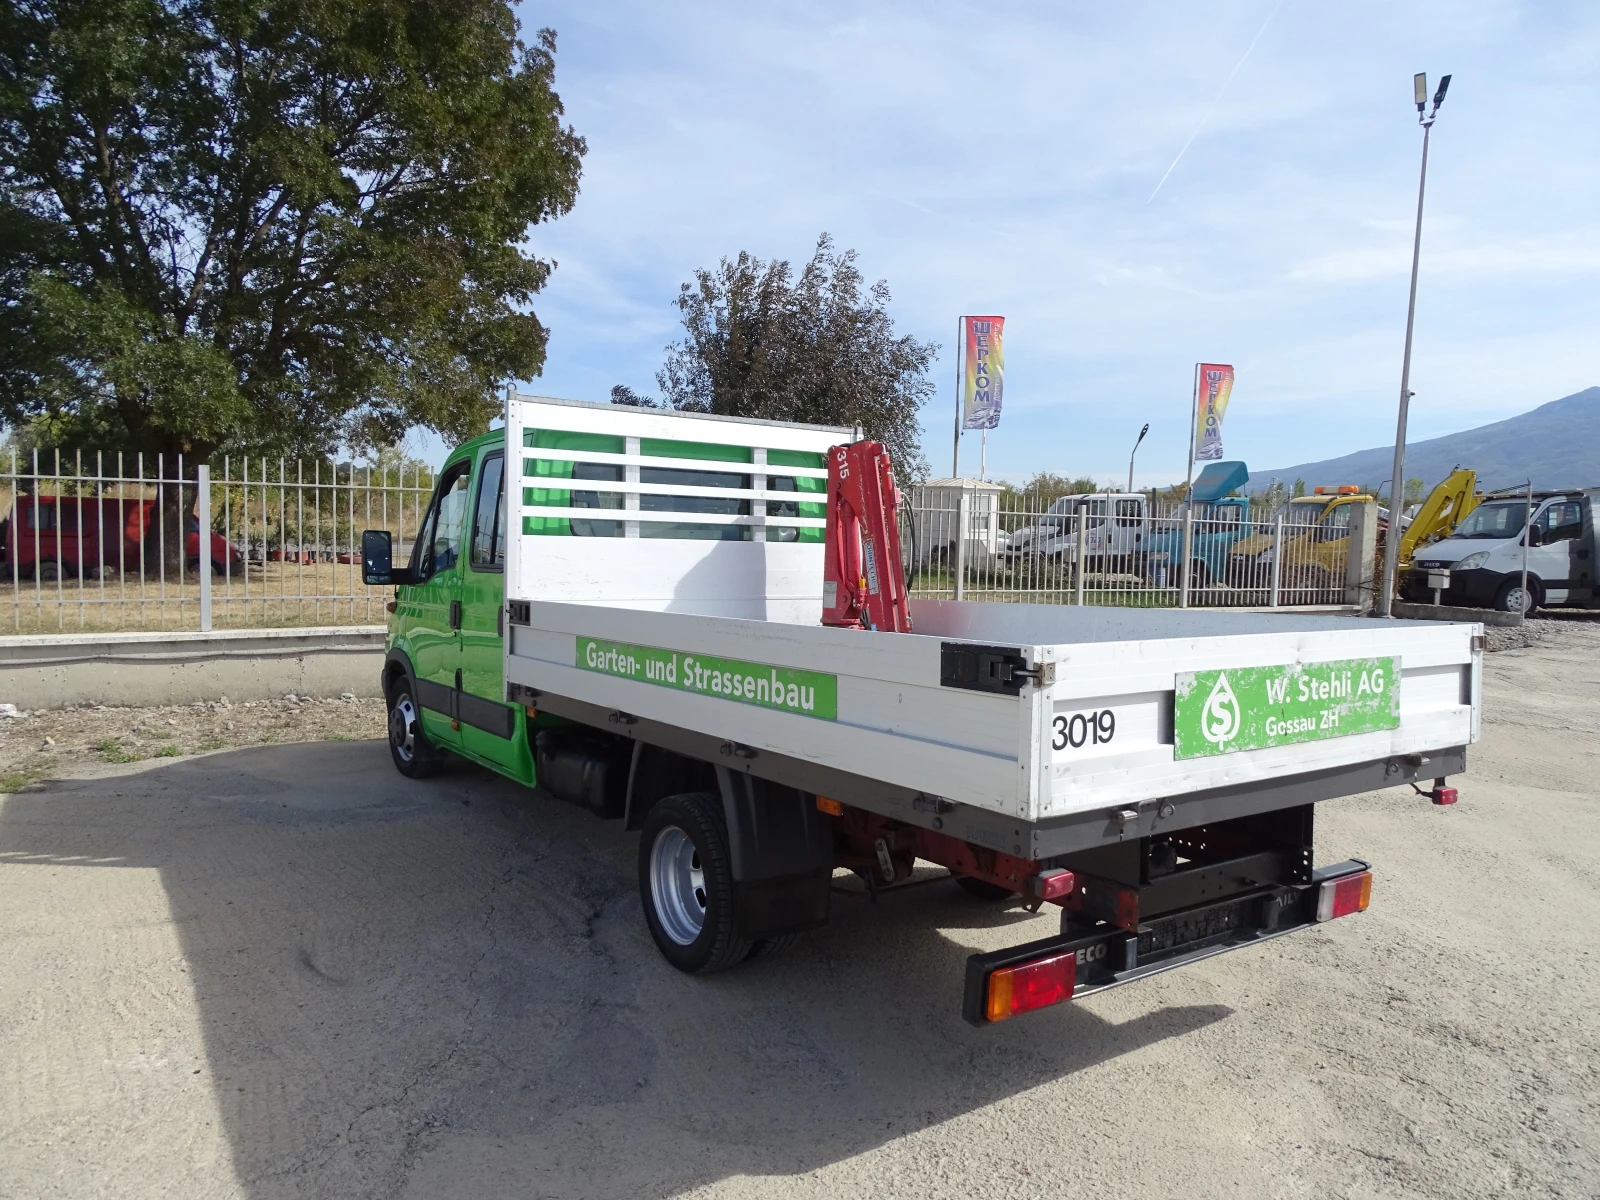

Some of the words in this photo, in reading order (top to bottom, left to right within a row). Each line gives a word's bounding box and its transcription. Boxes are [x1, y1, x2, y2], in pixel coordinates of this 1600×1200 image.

[973, 320, 992, 402] ШЕРКОМ
[1205, 370, 1223, 438] ШЕРКОМ
[837, 450, 850, 479] 315
[586, 642, 641, 675] Garten-
[645, 654, 677, 683] und
[683, 657, 815, 711] Strassenbau
[1266, 678, 1291, 705] W.
[1298, 671, 1352, 702] Stehli
[1357, 668, 1384, 697] AG
[1052, 709, 1116, 751] 3019
[1265, 716, 1316, 737] Gossau
[1320, 710, 1339, 729] ZH
[1275, 891, 1301, 907] AILY
[1075, 943, 1107, 966] ECO
